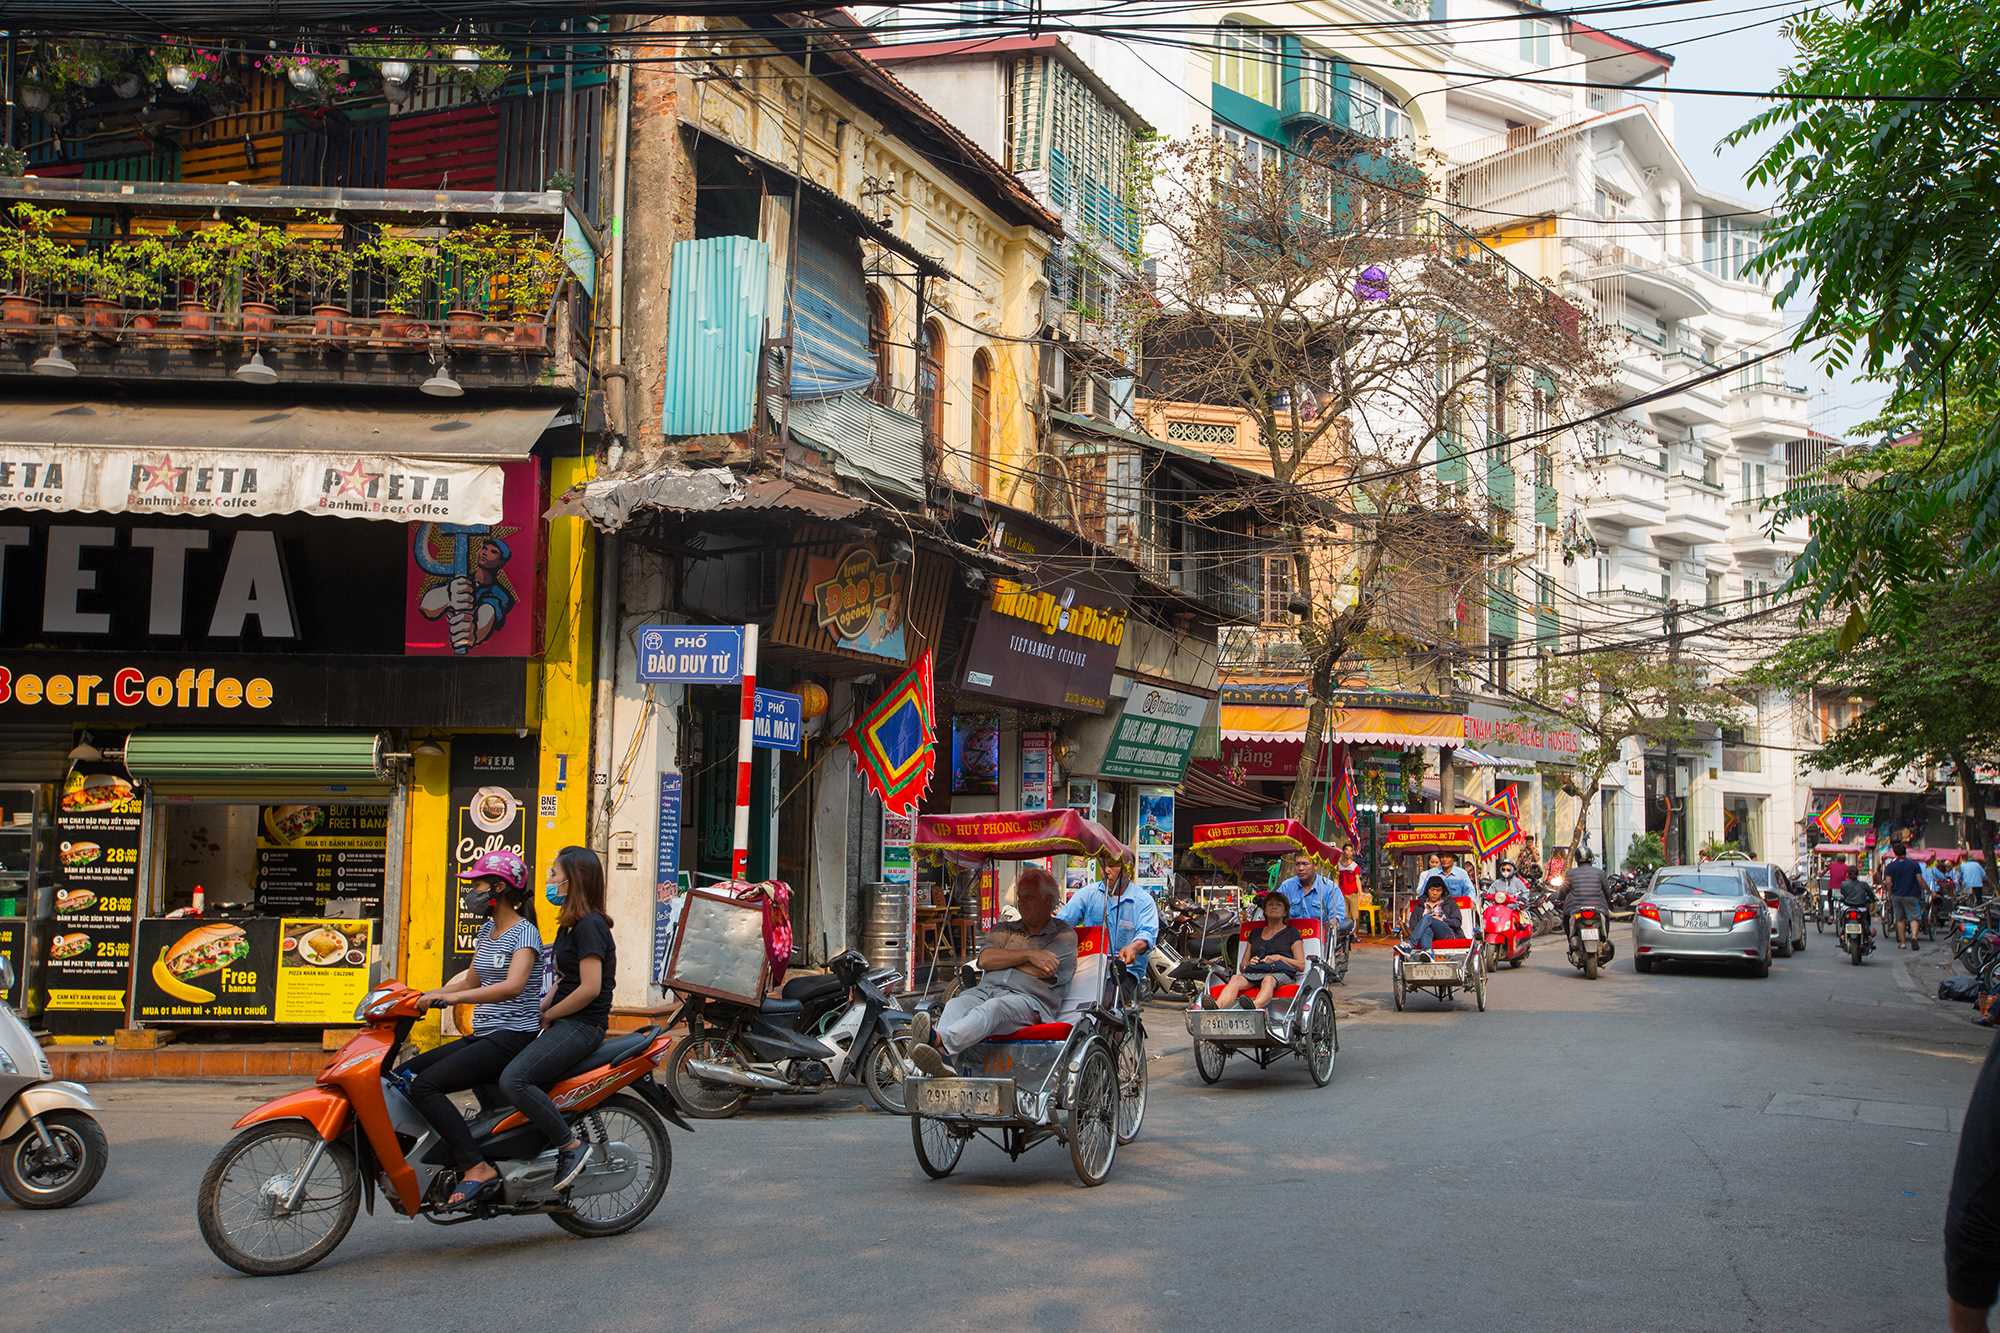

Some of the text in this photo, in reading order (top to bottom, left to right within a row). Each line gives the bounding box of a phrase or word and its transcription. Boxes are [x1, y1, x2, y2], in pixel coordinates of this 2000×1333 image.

[674, 632, 708, 648] PHỐ
[647, 650, 731, 673] ĐÀO DUY TỪ
[1057, 647, 1088, 667] CUISINE
[767, 699, 785, 714] PHỐ
[754, 714, 796, 741] MÃ MÂY
[1547, 730, 1578, 753] HOSTELS
[541, 796, 557, 806] BNE
[956, 824, 981, 836] HUY
[1027, 819, 1045, 833] JSC
[1222, 827, 1237, 836] HUY
[1262, 824, 1274, 833] JSC
[1274, 823, 1285, 834] 20
[1448, 832, 1456, 840] 77
[221, 967, 257, 985] Free
[222, 984, 257, 993] 1 banana
[142, 1007, 160, 1016] MUA
[160, 1007, 170, 1015] 01
[171, 1005, 192, 1015] BÁNH
[213, 1006, 232, 1017] TẶNG
[233, 1007, 242, 1015] 01
[244, 1004, 268, 1016] CHUỐI
